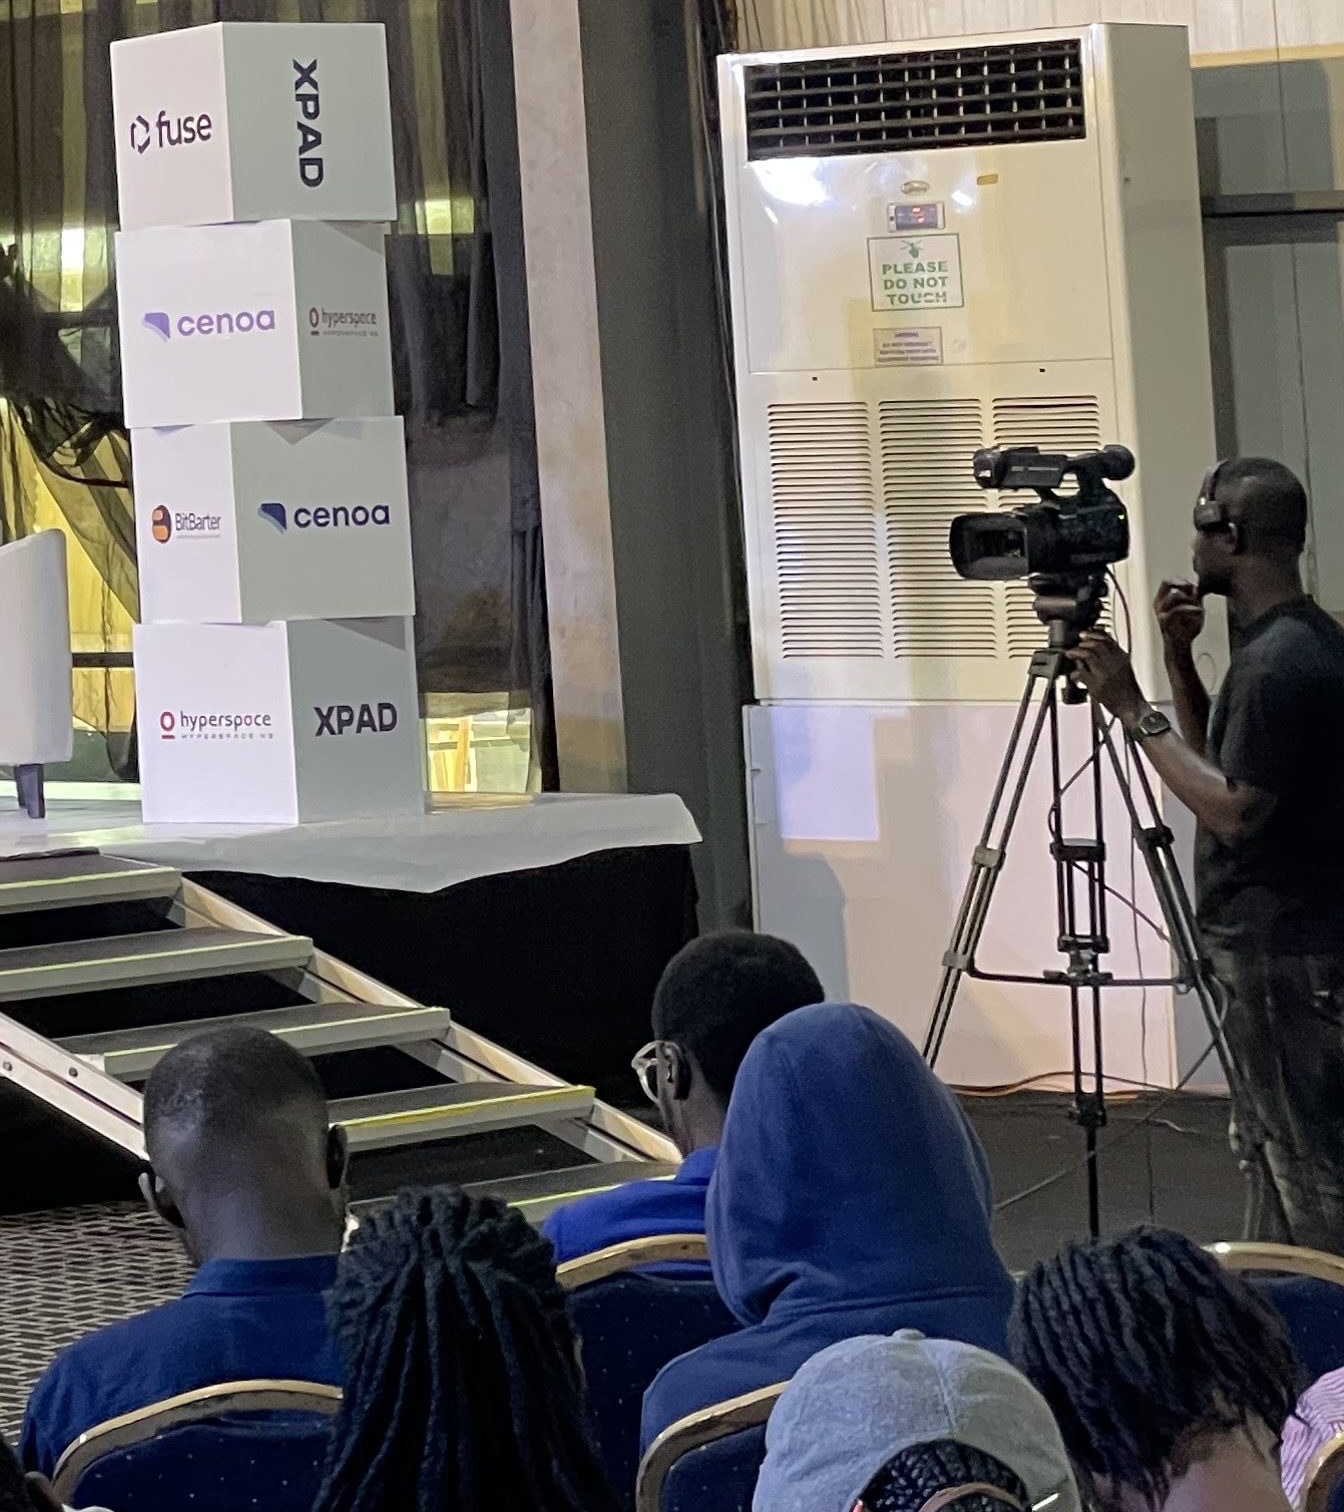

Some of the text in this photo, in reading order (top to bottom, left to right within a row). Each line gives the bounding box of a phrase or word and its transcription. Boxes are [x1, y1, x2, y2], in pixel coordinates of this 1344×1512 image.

[155, 110, 213, 149] fuse
[291, 57, 325, 189] XPAD
[881, 260, 949, 275] PLEASE
[883, 276, 949, 291] DO NOT
[886, 291, 947, 306] TOUCH
[177, 309, 276, 338] cenoa
[174, 511, 222, 532] BitBarter
[293, 504, 391, 529] cenoa
[179, 710, 273, 732] hyperspace
[313, 702, 399, 737] XPAD
